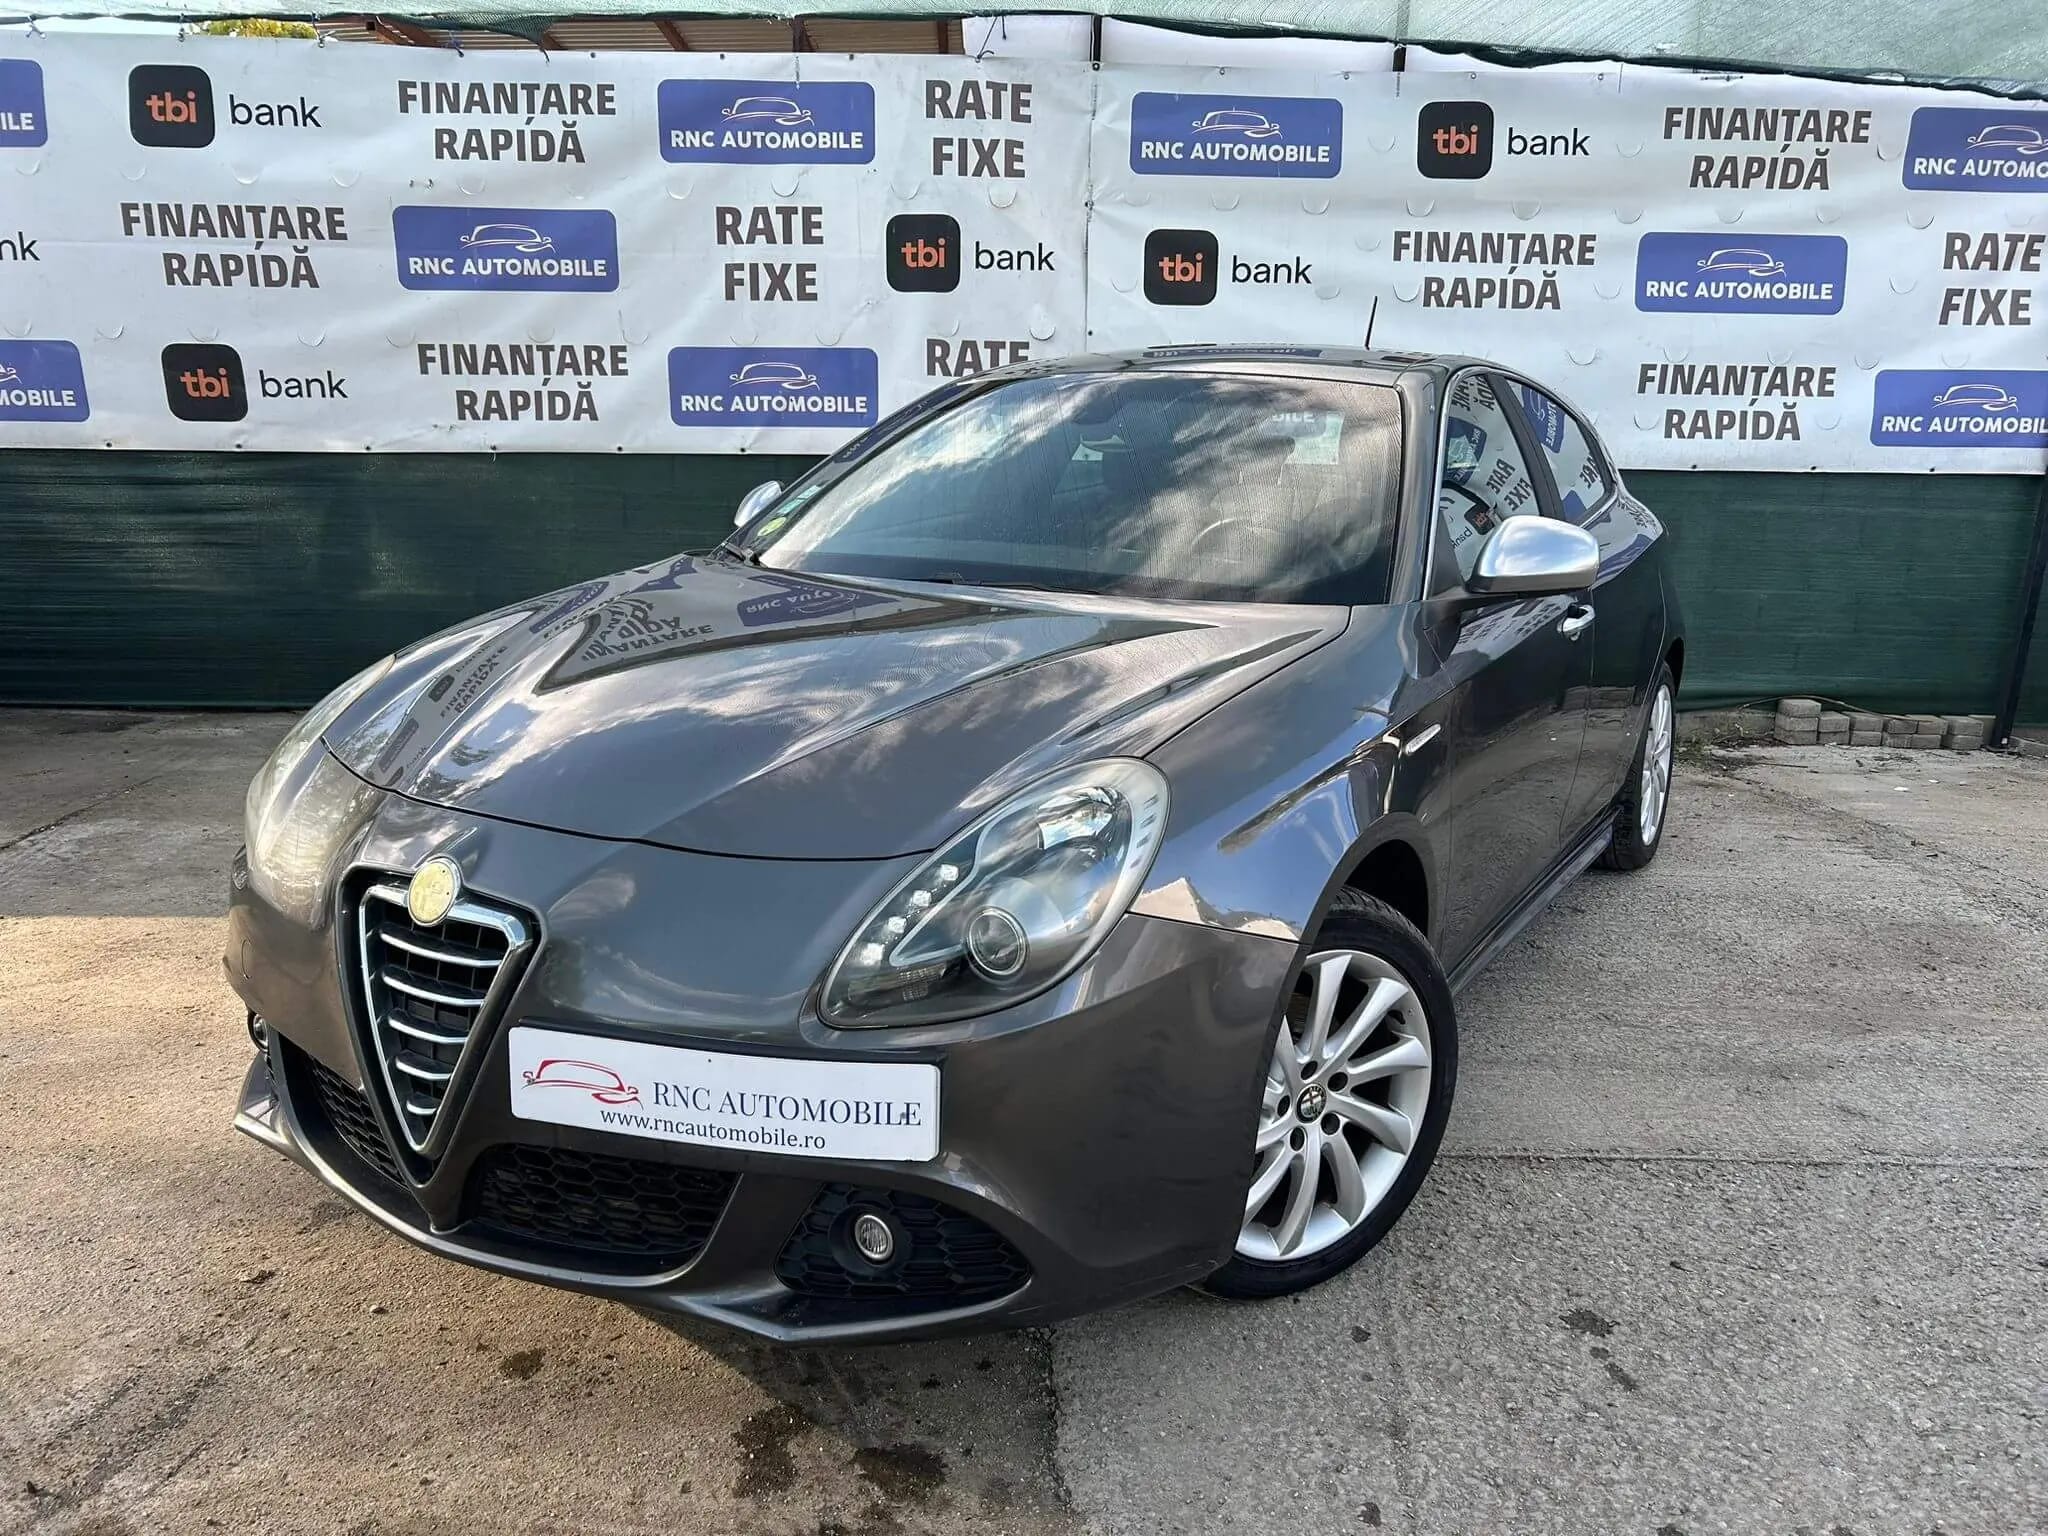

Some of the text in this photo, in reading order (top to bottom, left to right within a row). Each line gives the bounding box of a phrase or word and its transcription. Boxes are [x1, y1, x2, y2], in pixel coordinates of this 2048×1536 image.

[147, 93, 321, 127] tbi bank
[926, 80, 1032, 123] RATE
[672, 131, 863, 148] RNC AUTOMOBILE
[1142, 142, 1329, 162] RNC AUTOMOBILE
[1435, 127, 1590, 155] tbi bank
[934, 138, 1025, 177] FIXE
[1914, 158, 1956, 174] RNC
[716, 207, 823, 244] RATE
[409, 258, 606, 276] RNC AUTOMOBILE
[903, 240, 1054, 270] tbi bank
[1944, 233, 2045, 271] RATE
[725, 263, 817, 301] FIXE
[1161, 255, 1312, 284] tbi bank
[1647, 281, 1833, 299] RNC AUTOMOBILE
[1939, 289, 2031, 325] FIXE
[927, 339, 1030, 377] RATE
[182, 369, 347, 398] tbi bank
[682, 396, 867, 412] RNC AUTOMOBILE
[1882, 416, 1923, 432] RNC
[653, 1081, 922, 1127] RNC AUTOMOBILE
[600, 1109, 827, 1150] www.rncautomobile.ro
